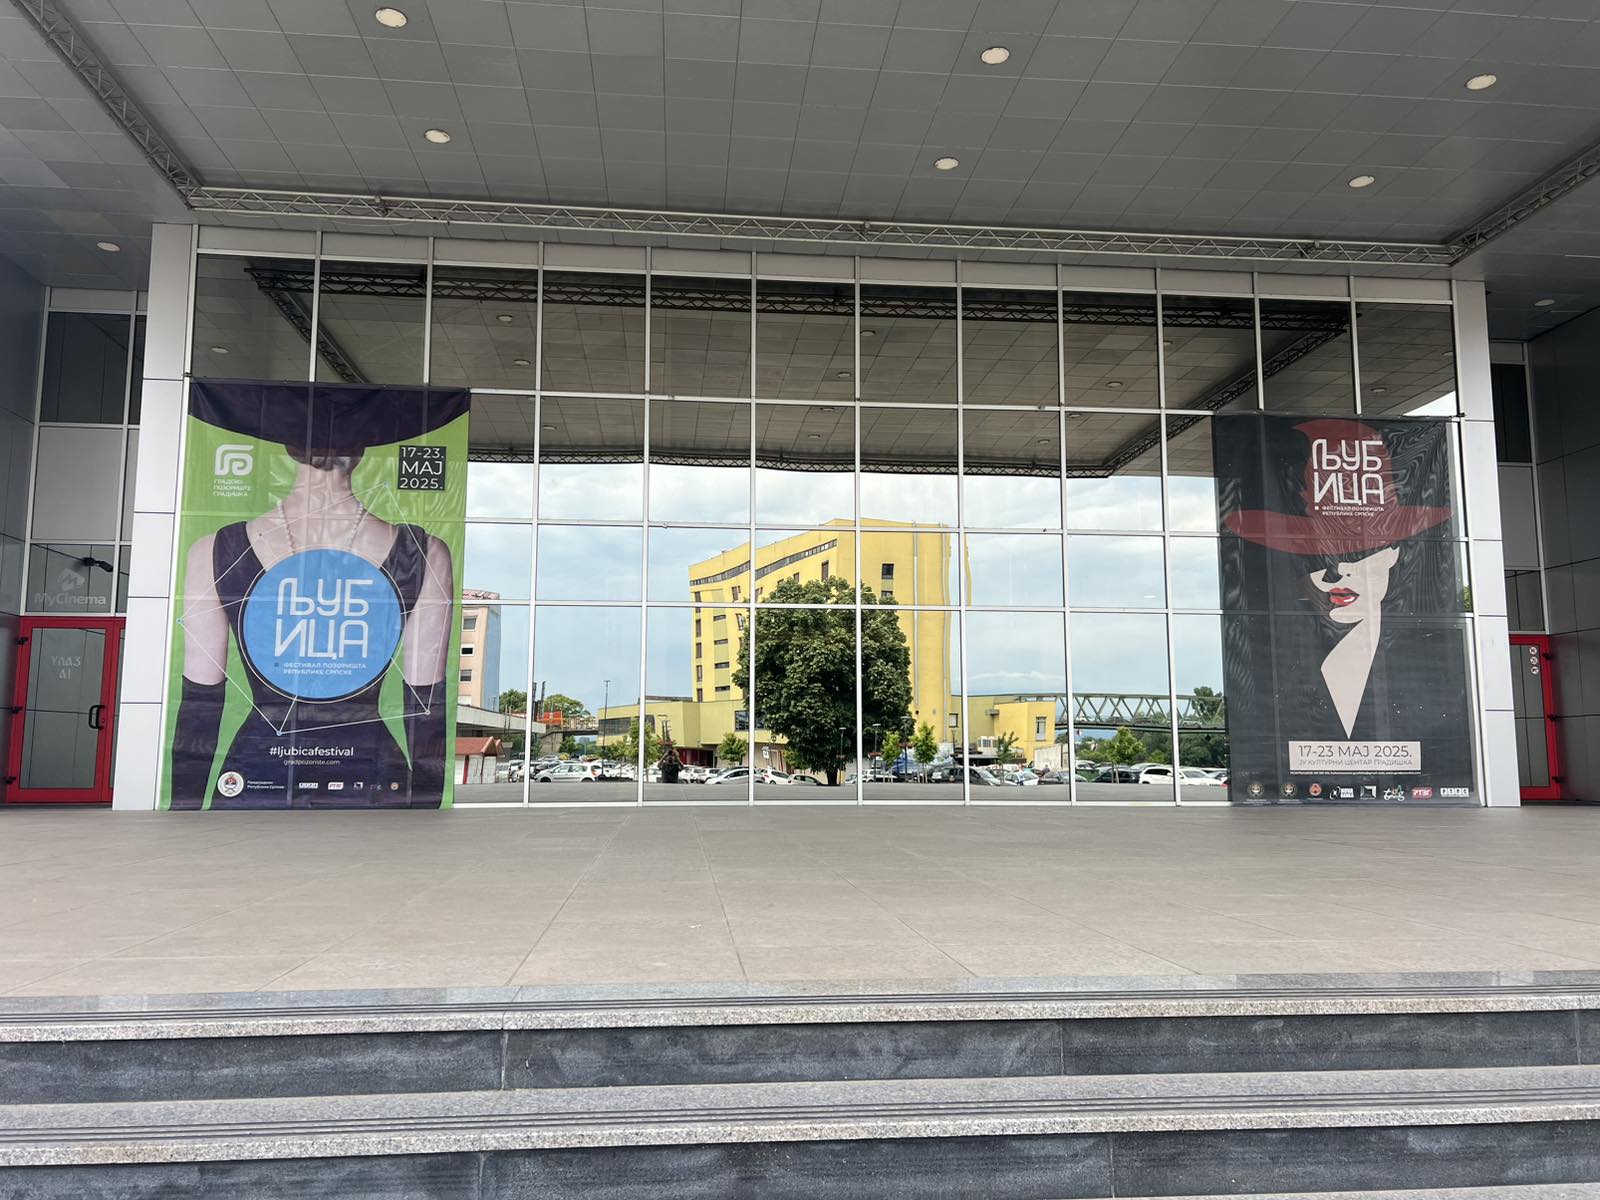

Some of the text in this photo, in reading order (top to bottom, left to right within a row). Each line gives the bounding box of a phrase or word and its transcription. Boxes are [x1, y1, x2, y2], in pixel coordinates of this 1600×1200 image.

[401, 446, 444, 459] 17-23.
[1312, 438, 1383, 471] ЉУБ
[402, 460, 443, 475] МАЈ
[400, 477, 443, 489] 2025.
[1313, 471, 1385, 506] ИЦА
[34, 592, 106, 606] MyCinema
[276, 577, 374, 617] ЉУБ
[274, 618, 369, 660] ИЦА
[269, 746, 354, 757] #ljubicafestival
[1298, 745, 1334, 758] 17-23
[1374, 745, 1413, 758] 2025.
